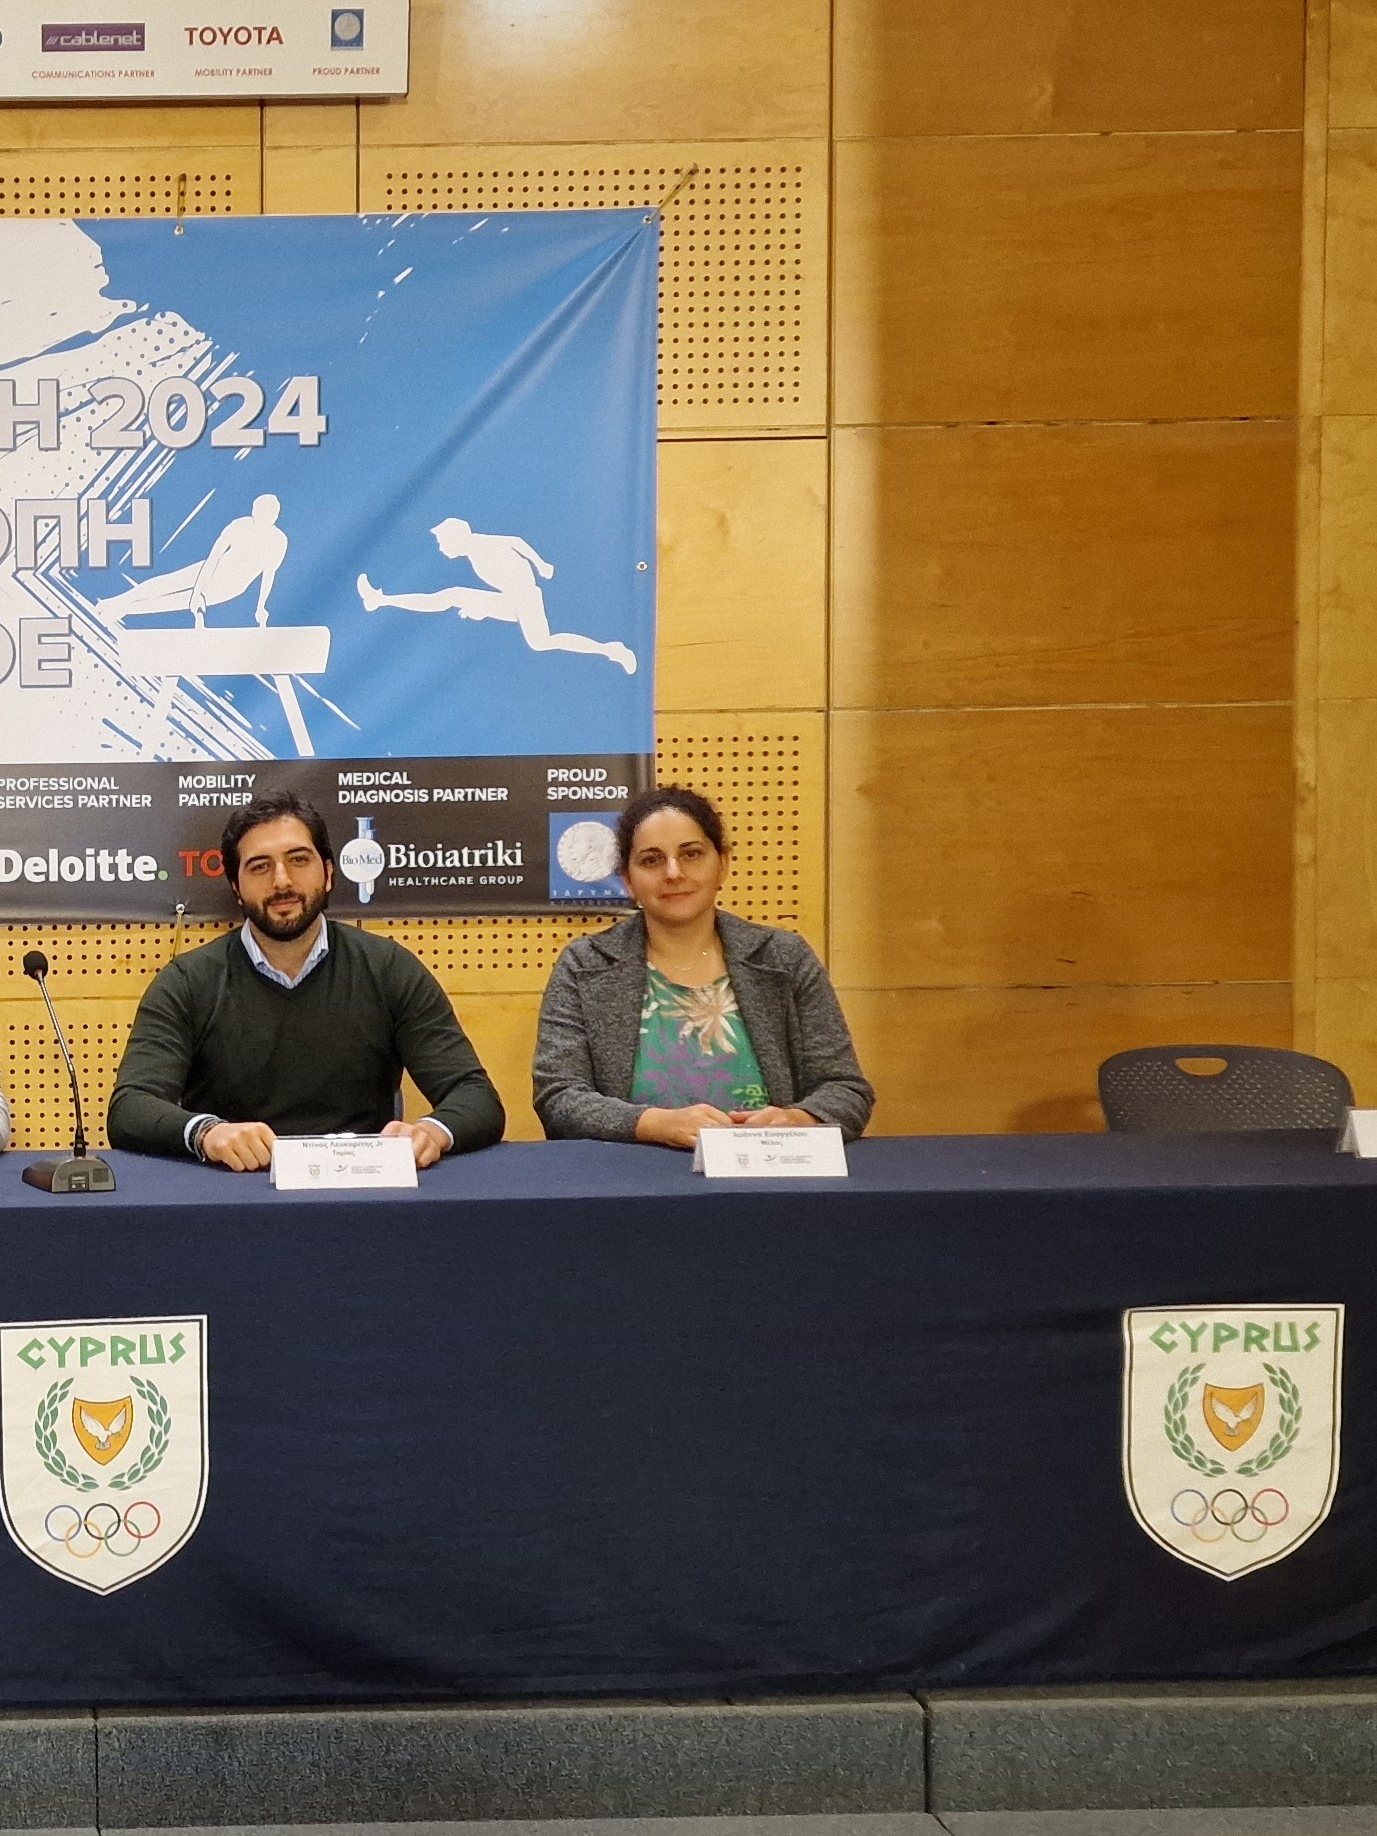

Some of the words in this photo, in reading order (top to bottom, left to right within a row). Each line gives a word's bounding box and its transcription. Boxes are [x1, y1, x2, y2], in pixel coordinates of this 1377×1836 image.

[184, 26, 284, 46] TOYOTA
[31, 69, 116, 79] COMMUNICATIONS
[118, 69, 155, 78] PARTNER
[194, 68, 234, 77] MOBILITY
[236, 67, 273, 76] PARTNER
[312, 67, 342, 76] PROUD
[344, 66, 381, 75] PARTNER
[88, 374, 328, 450] 2024
[178, 774, 256, 789] MOBILITY
[338, 771, 412, 786] MEDICAL
[547, 768, 607, 782] PROUD
[78, 794, 152, 808] PARTNER
[178, 792, 253, 806] PARTNER
[338, 789, 429, 804] DIAGNOSIS
[433, 788, 508, 802] PARTNER
[546, 786, 629, 801] SPONSOR
[387, 840, 524, 868] Bioiatriki
[388, 876, 474, 887] HEALTHCARE
[479, 875, 524, 885] GROUP
[1148, 1320, 1322, 1355] CYPRUS
[16, 1331, 187, 1371] CYPRUS
